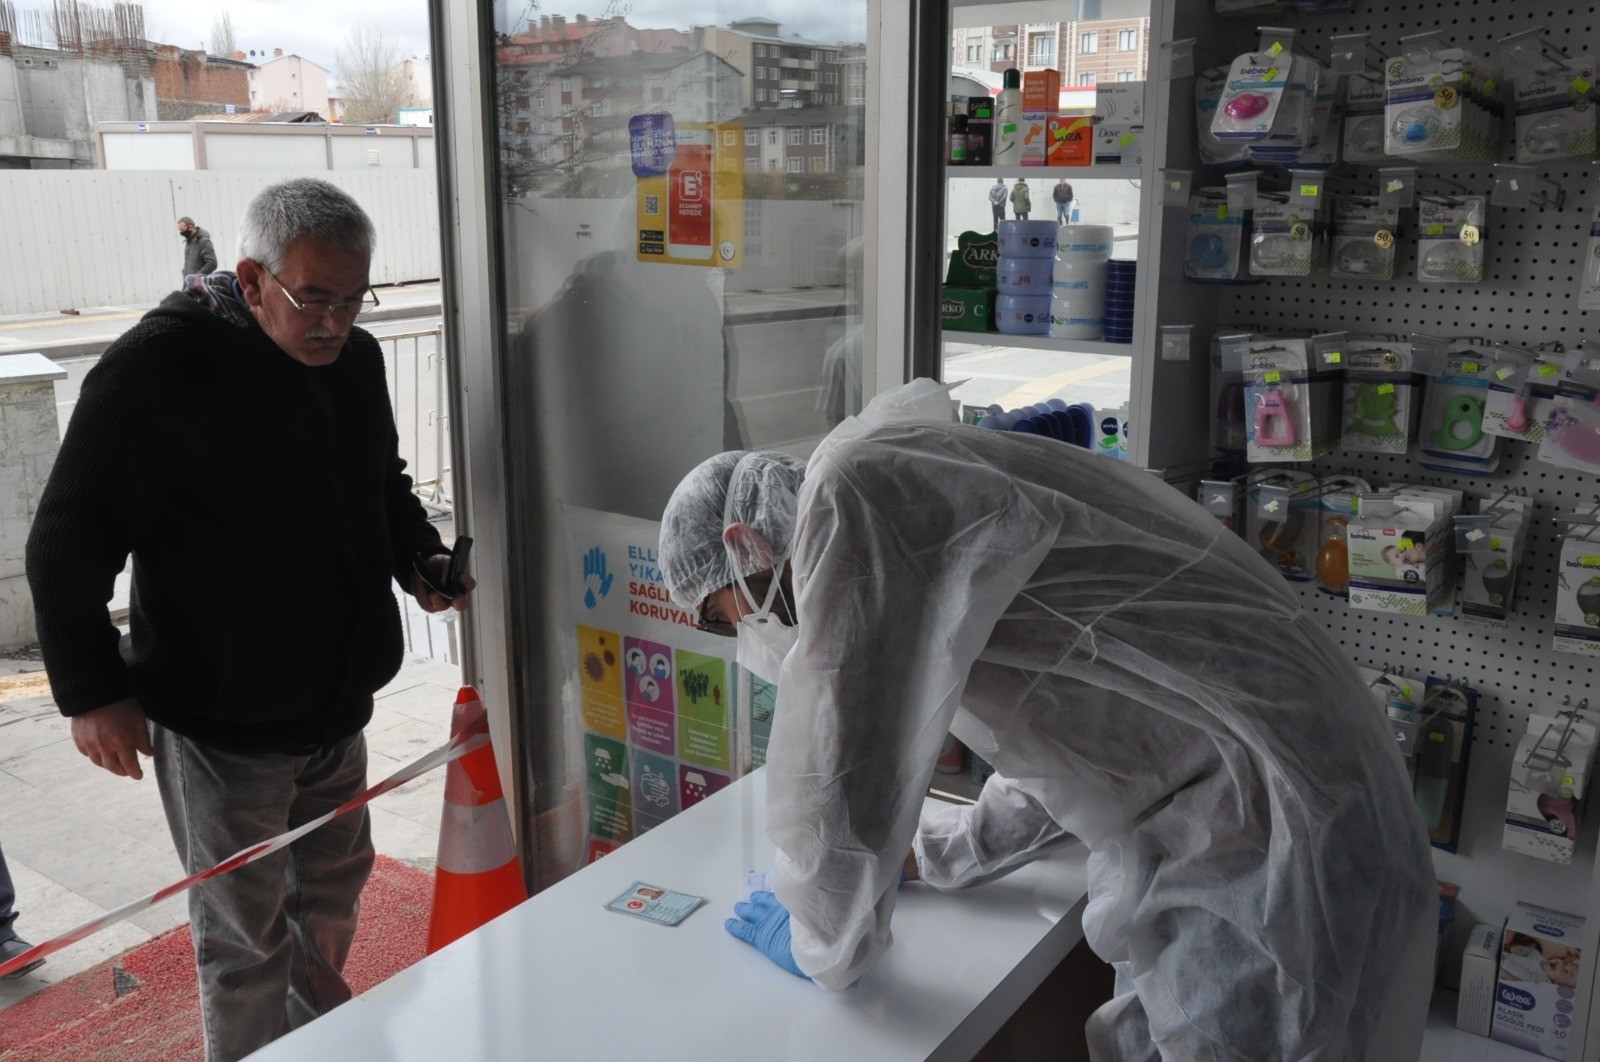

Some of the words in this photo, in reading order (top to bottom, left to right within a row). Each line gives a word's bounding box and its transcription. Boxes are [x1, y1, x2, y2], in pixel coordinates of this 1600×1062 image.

[1389, 76, 1424, 86] bambino
[1350, 91, 1383, 101] bambino
[1439, 88, 1453, 101] 50
[1519, 85, 1556, 98] bambino
[1098, 127, 1121, 138] Dove
[679, 209, 703, 217] NEREDE
[1423, 216, 1453, 224] bambino
[1294, 228, 1305, 236] 50
[1463, 231, 1475, 240] 50
[1377, 233, 1388, 242] 50
[967, 247, 999, 261] ARK
[1348, 359, 1379, 368] bambino
[1384, 356, 1395, 364] 50
[1350, 533, 1376, 541] bambino
[628, 545, 659, 563] ELL
[629, 563, 664, 582] YIKA
[629, 581, 670, 603] SAĞLI
[630, 600, 700, 628] KORUYAL
[1552, 1030, 1567, 1039] 40
